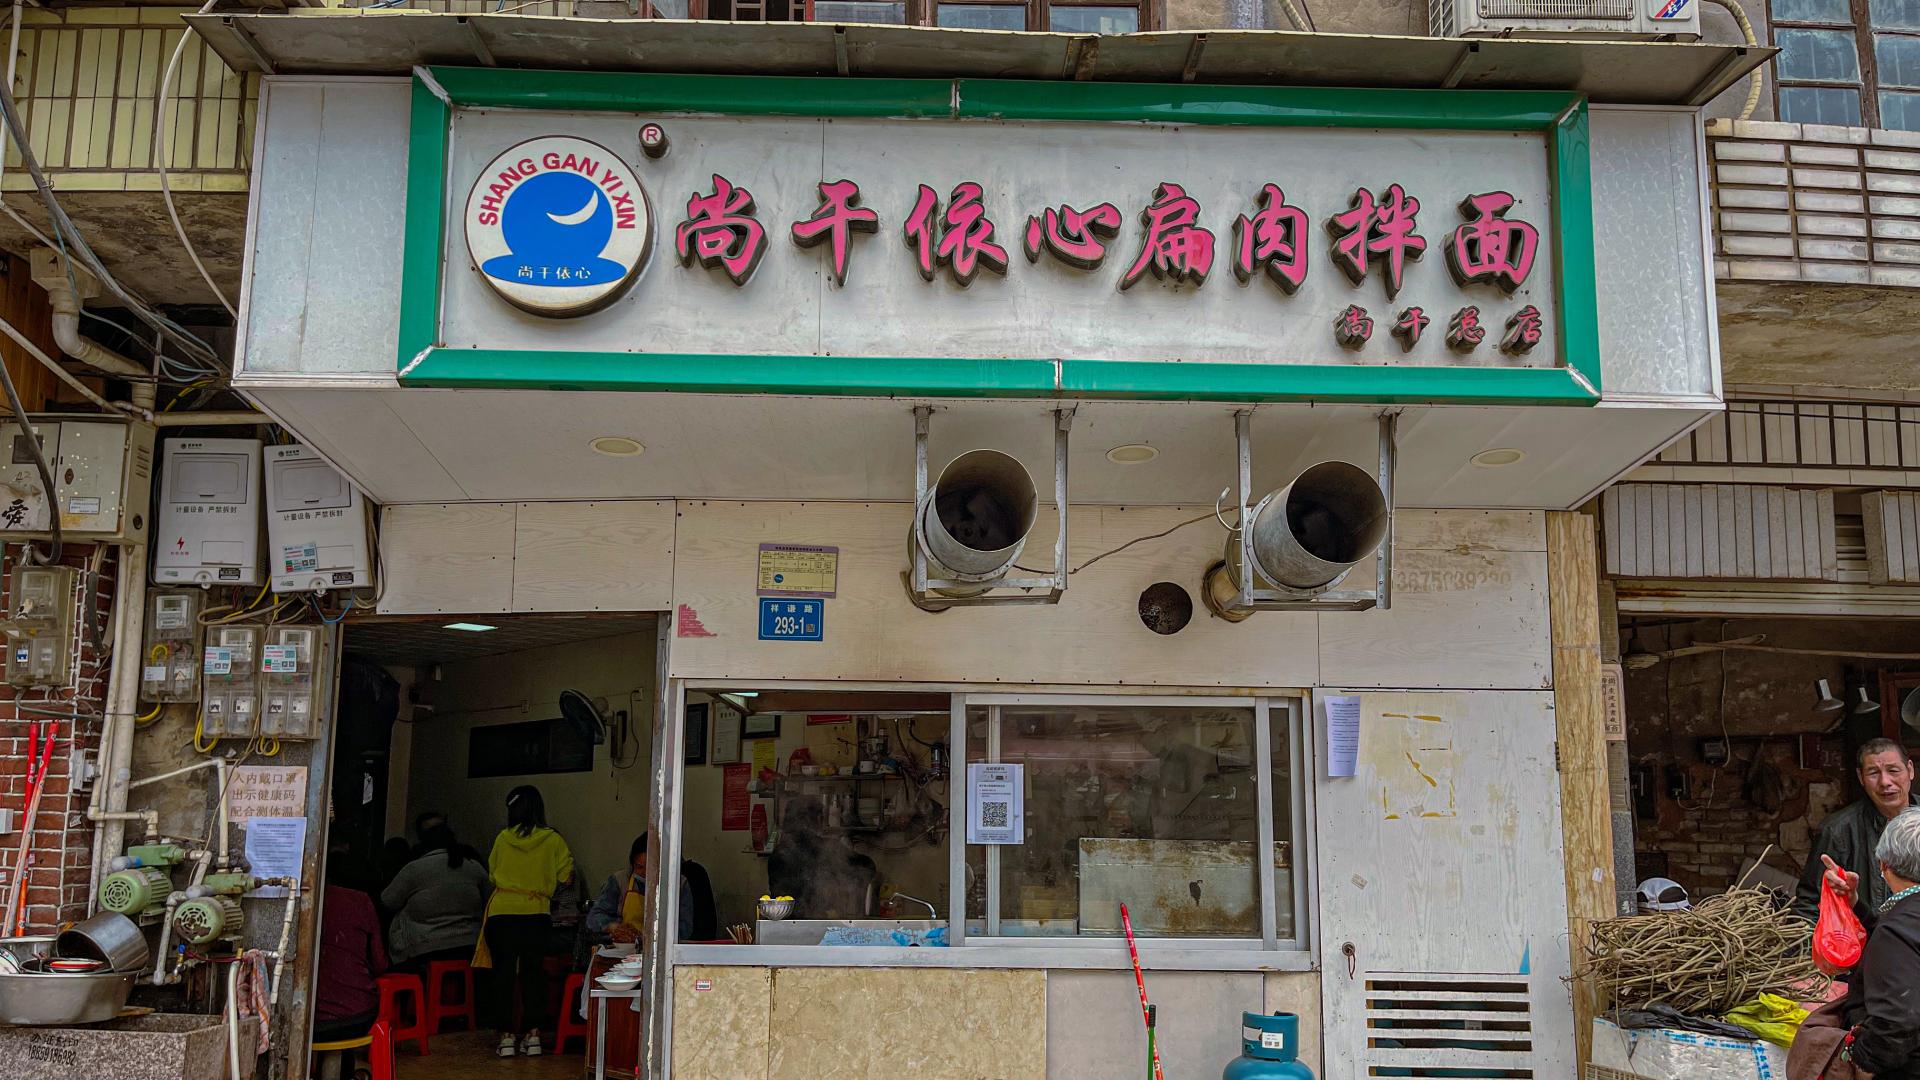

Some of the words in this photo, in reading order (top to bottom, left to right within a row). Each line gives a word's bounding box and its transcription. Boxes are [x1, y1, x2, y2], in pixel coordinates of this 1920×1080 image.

[478, 158, 538, 226] SHANG
[542, 152, 600, 177] GAN
[600, 169, 624, 193] YI
[612, 190, 636, 229] XIN
[676, 174, 1539, 299] 尚干依心扁肉拌面
[518, 266, 591, 280] 尚干依心
[1336, 304, 1543, 355] 尚干总店
[774, 616, 805, 635] 293-1
[233, 772, 297, 785] 入内戴口罩
[232, 789, 296, 801] 出示健康码
[230, 805, 293, 817] 配合测体温
